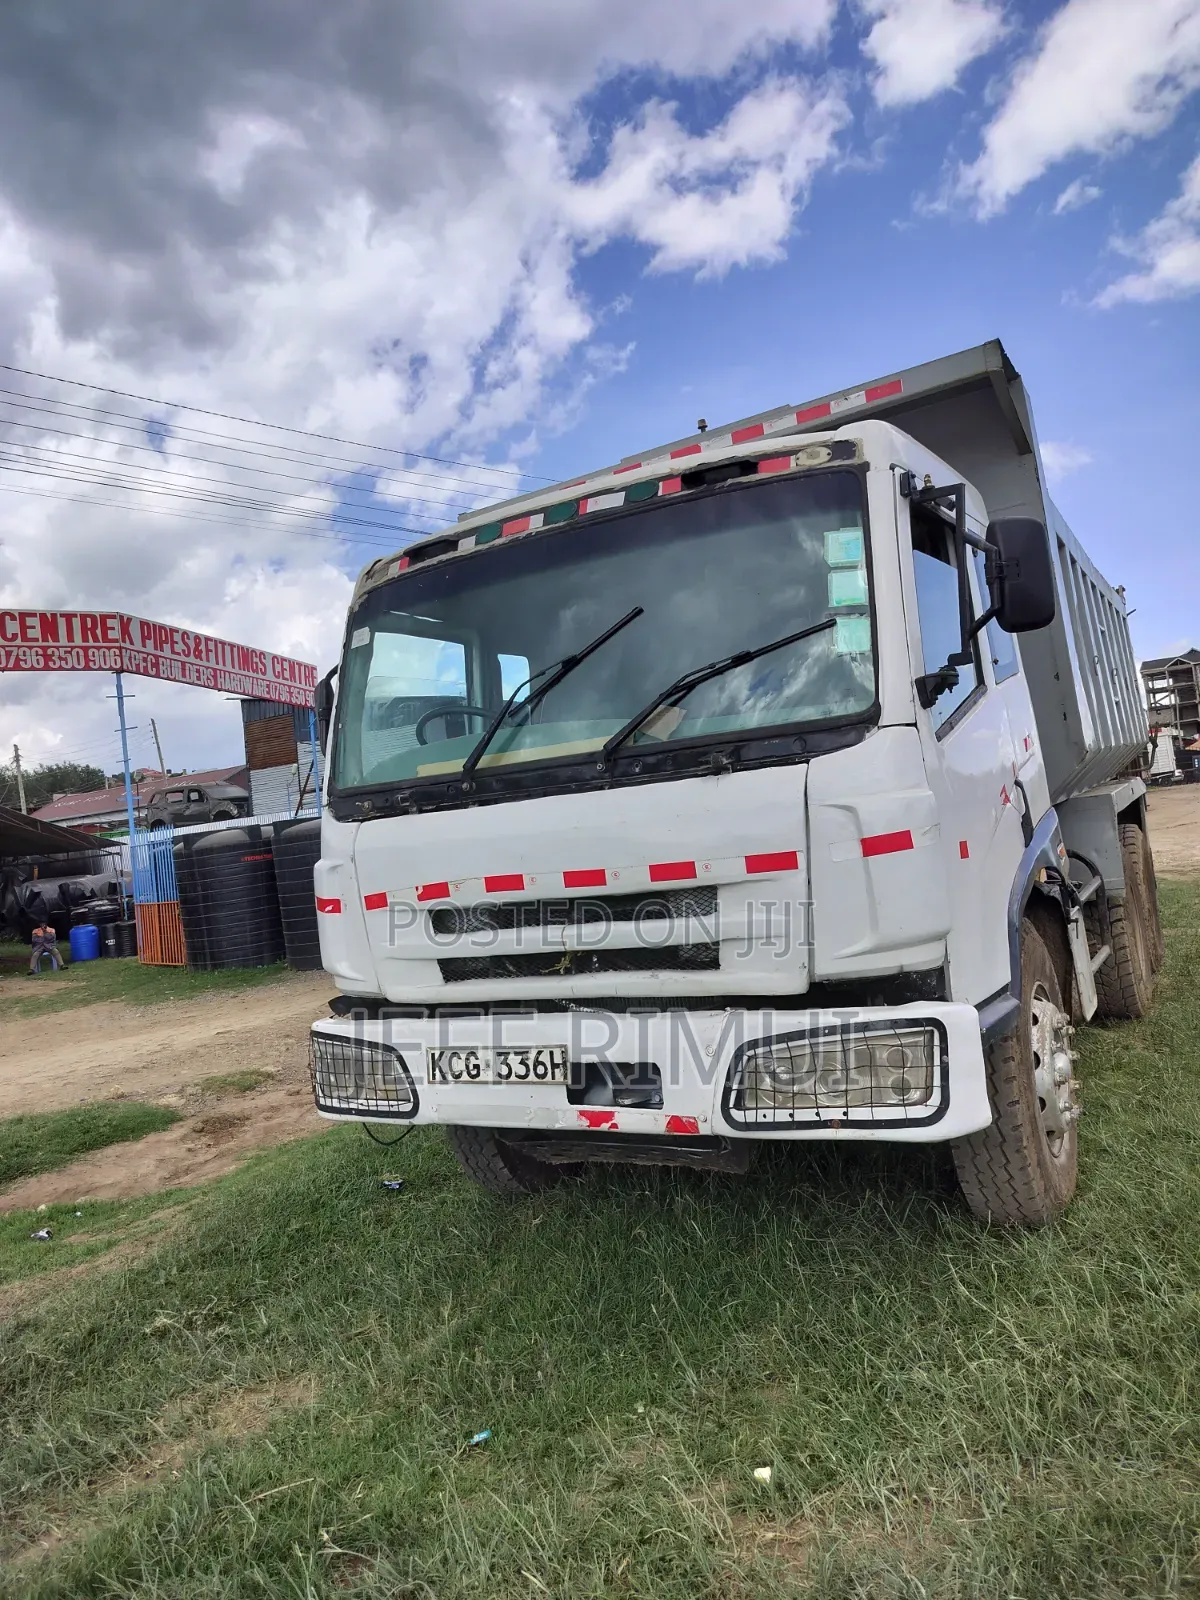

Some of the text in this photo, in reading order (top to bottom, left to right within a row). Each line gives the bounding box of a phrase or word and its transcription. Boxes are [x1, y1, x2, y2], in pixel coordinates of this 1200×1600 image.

[0, 611, 317, 689] CENTREK PIPES&FITTINGS CENTRE
[47, 647, 84, 669] 350
[88, 648, 120, 669] 906
[122, 648, 156, 676] KPFC
[159, 657, 214, 688] BUILDERS
[216, 669, 270, 698] HARDWARE
[290, 686, 305, 706] 350
[431, 1049, 567, 1081] KCG 336H
